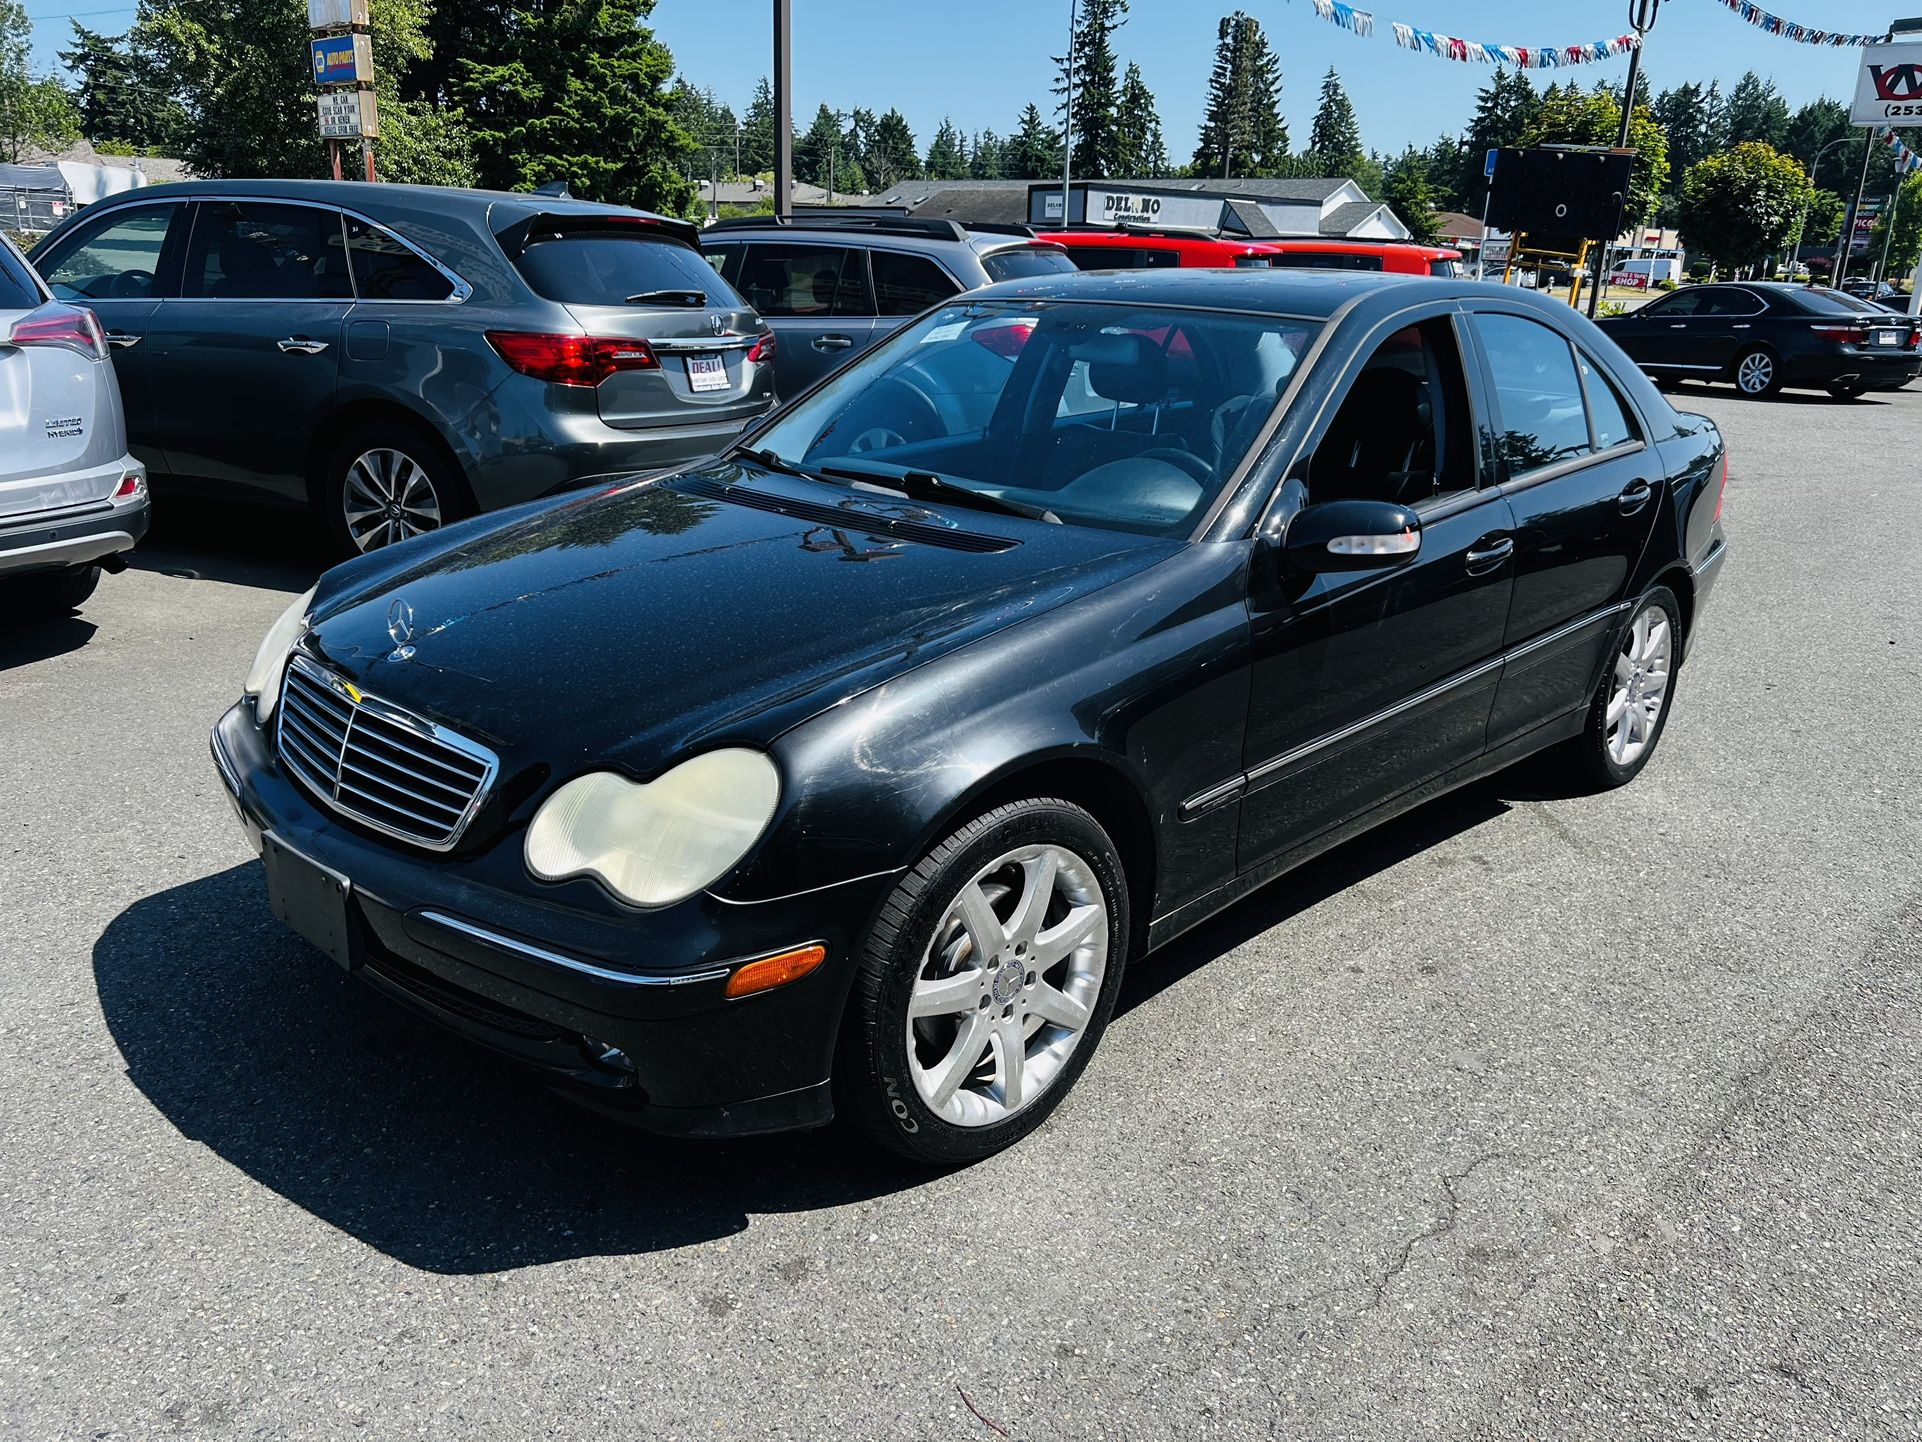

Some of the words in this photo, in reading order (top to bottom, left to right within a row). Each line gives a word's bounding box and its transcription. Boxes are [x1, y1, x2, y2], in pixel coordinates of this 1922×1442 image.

[327, 52, 339, 66] AUTO
[339, 50, 354, 64] PARTS
[322, 107, 332, 116] CODE
[333, 106, 343, 115] SCAN
[349, 124, 359, 134] FREE
[1113, 213, 1151, 223] Construction
[1615, 278, 1639, 286] SHOP
[692, 361, 721, 374] DEAL!
